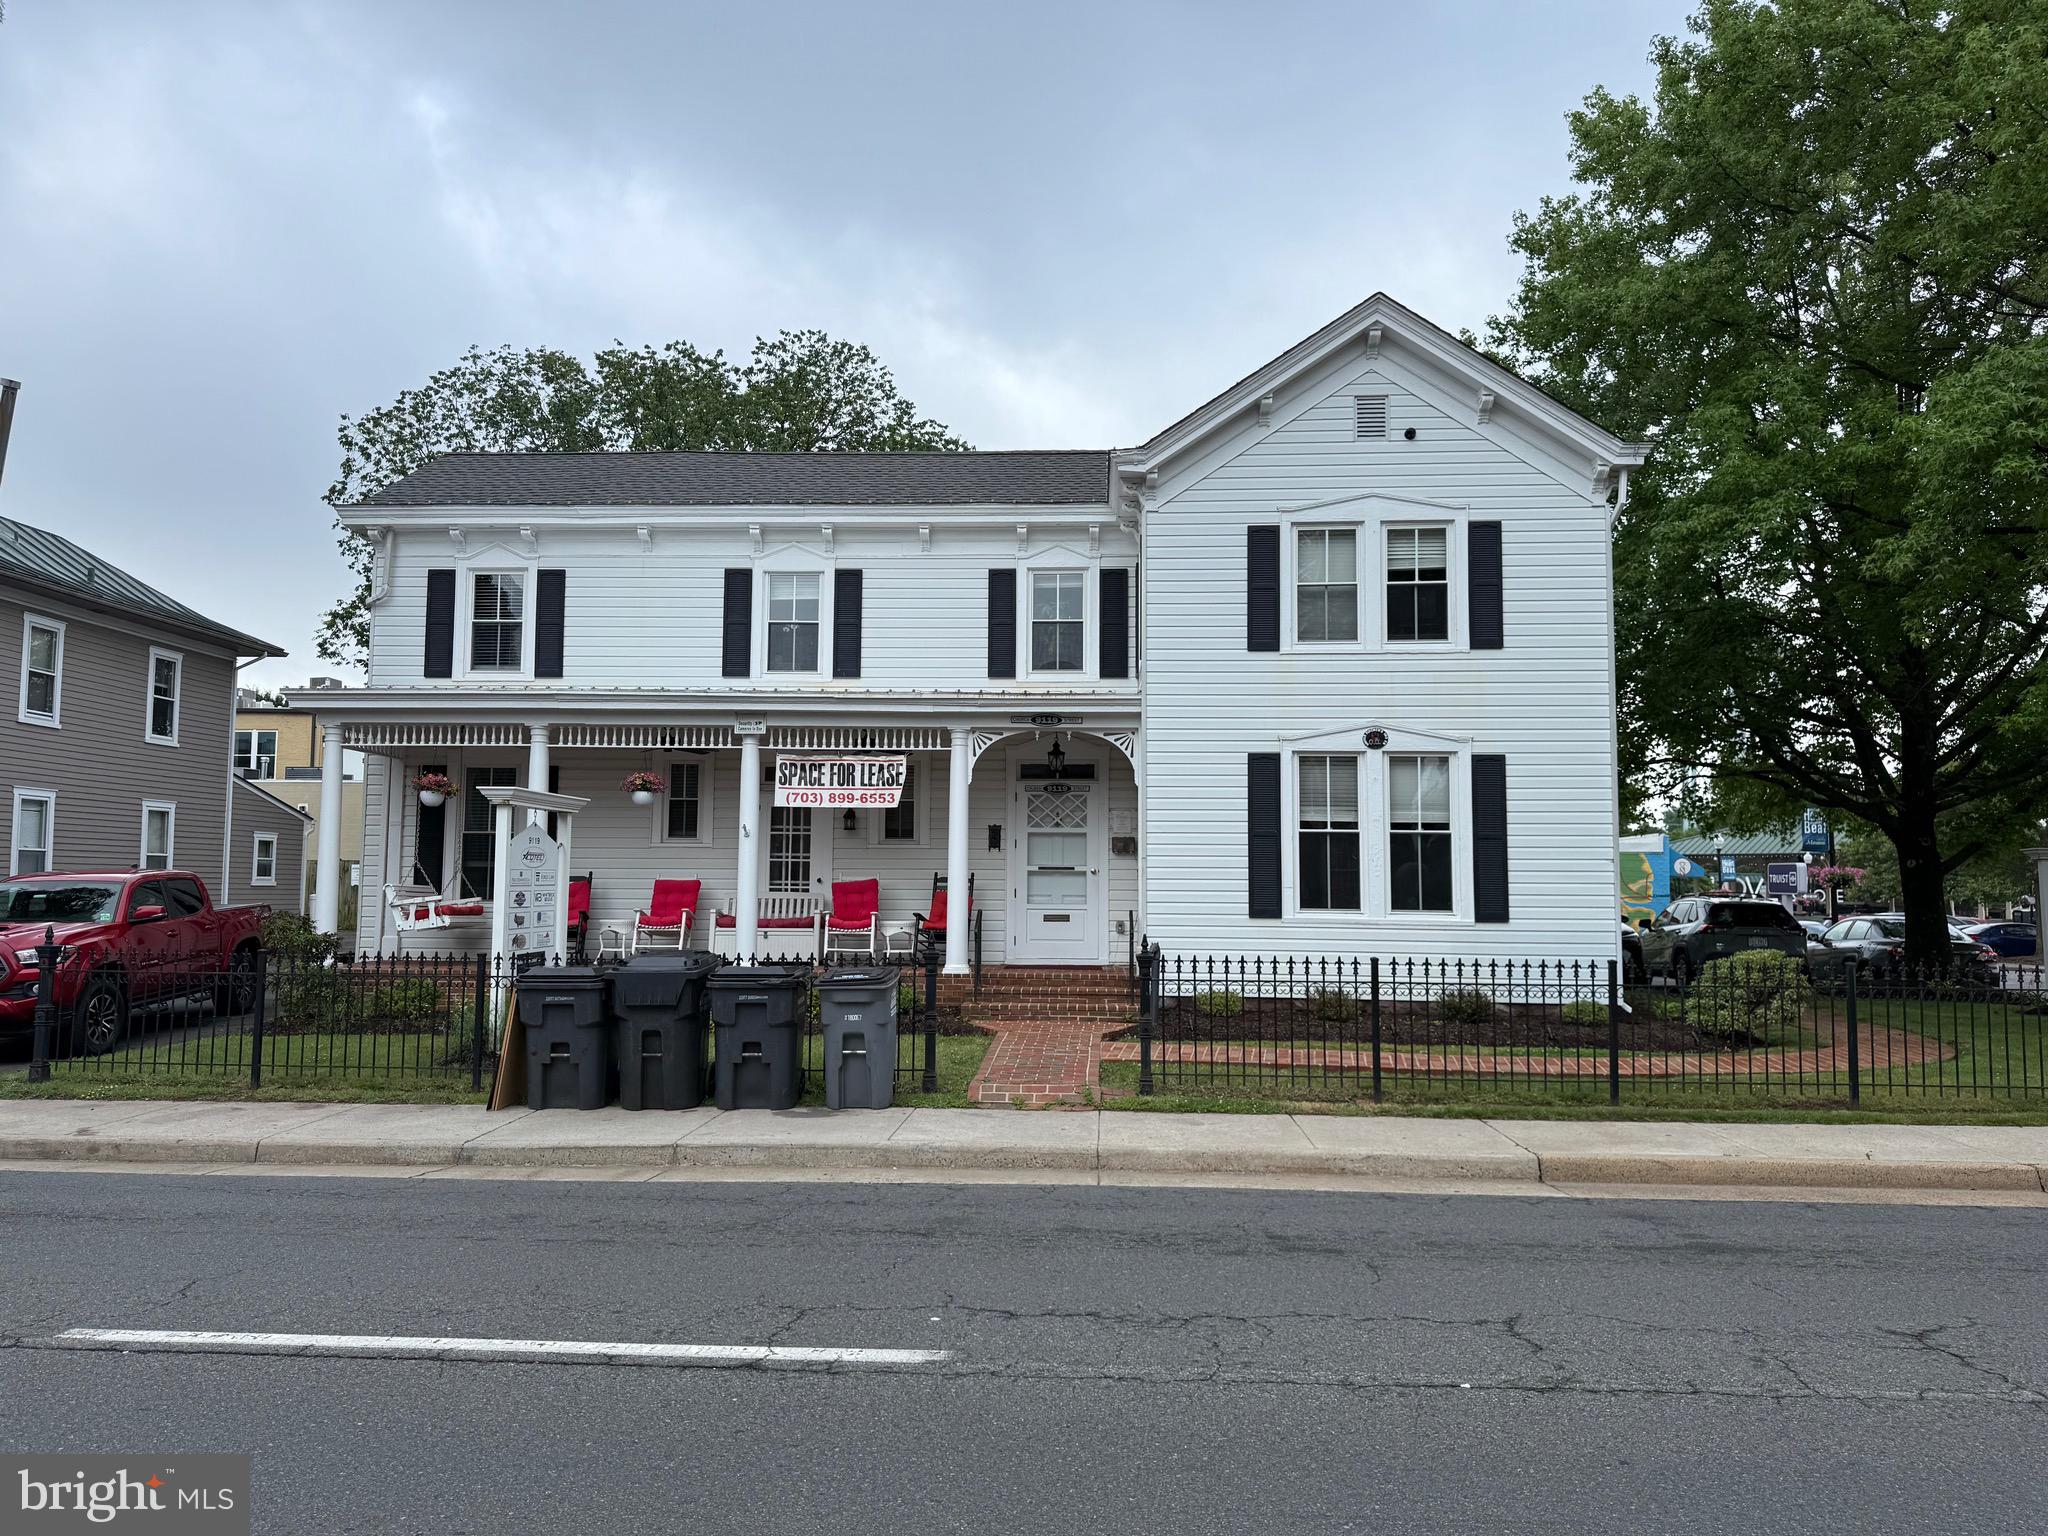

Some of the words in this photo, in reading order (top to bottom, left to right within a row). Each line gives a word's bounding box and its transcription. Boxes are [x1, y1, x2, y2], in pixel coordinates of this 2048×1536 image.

[778, 762, 826, 786] SPACE
[829, 762, 856, 787] FOR
[860, 763, 903, 787] LEASE
[786, 792, 823, 805] (703)
[828, 793, 895, 804] 899-6553
[529, 837, 541, 845] 9119
[1769, 874, 1789, 883] TRUIST
